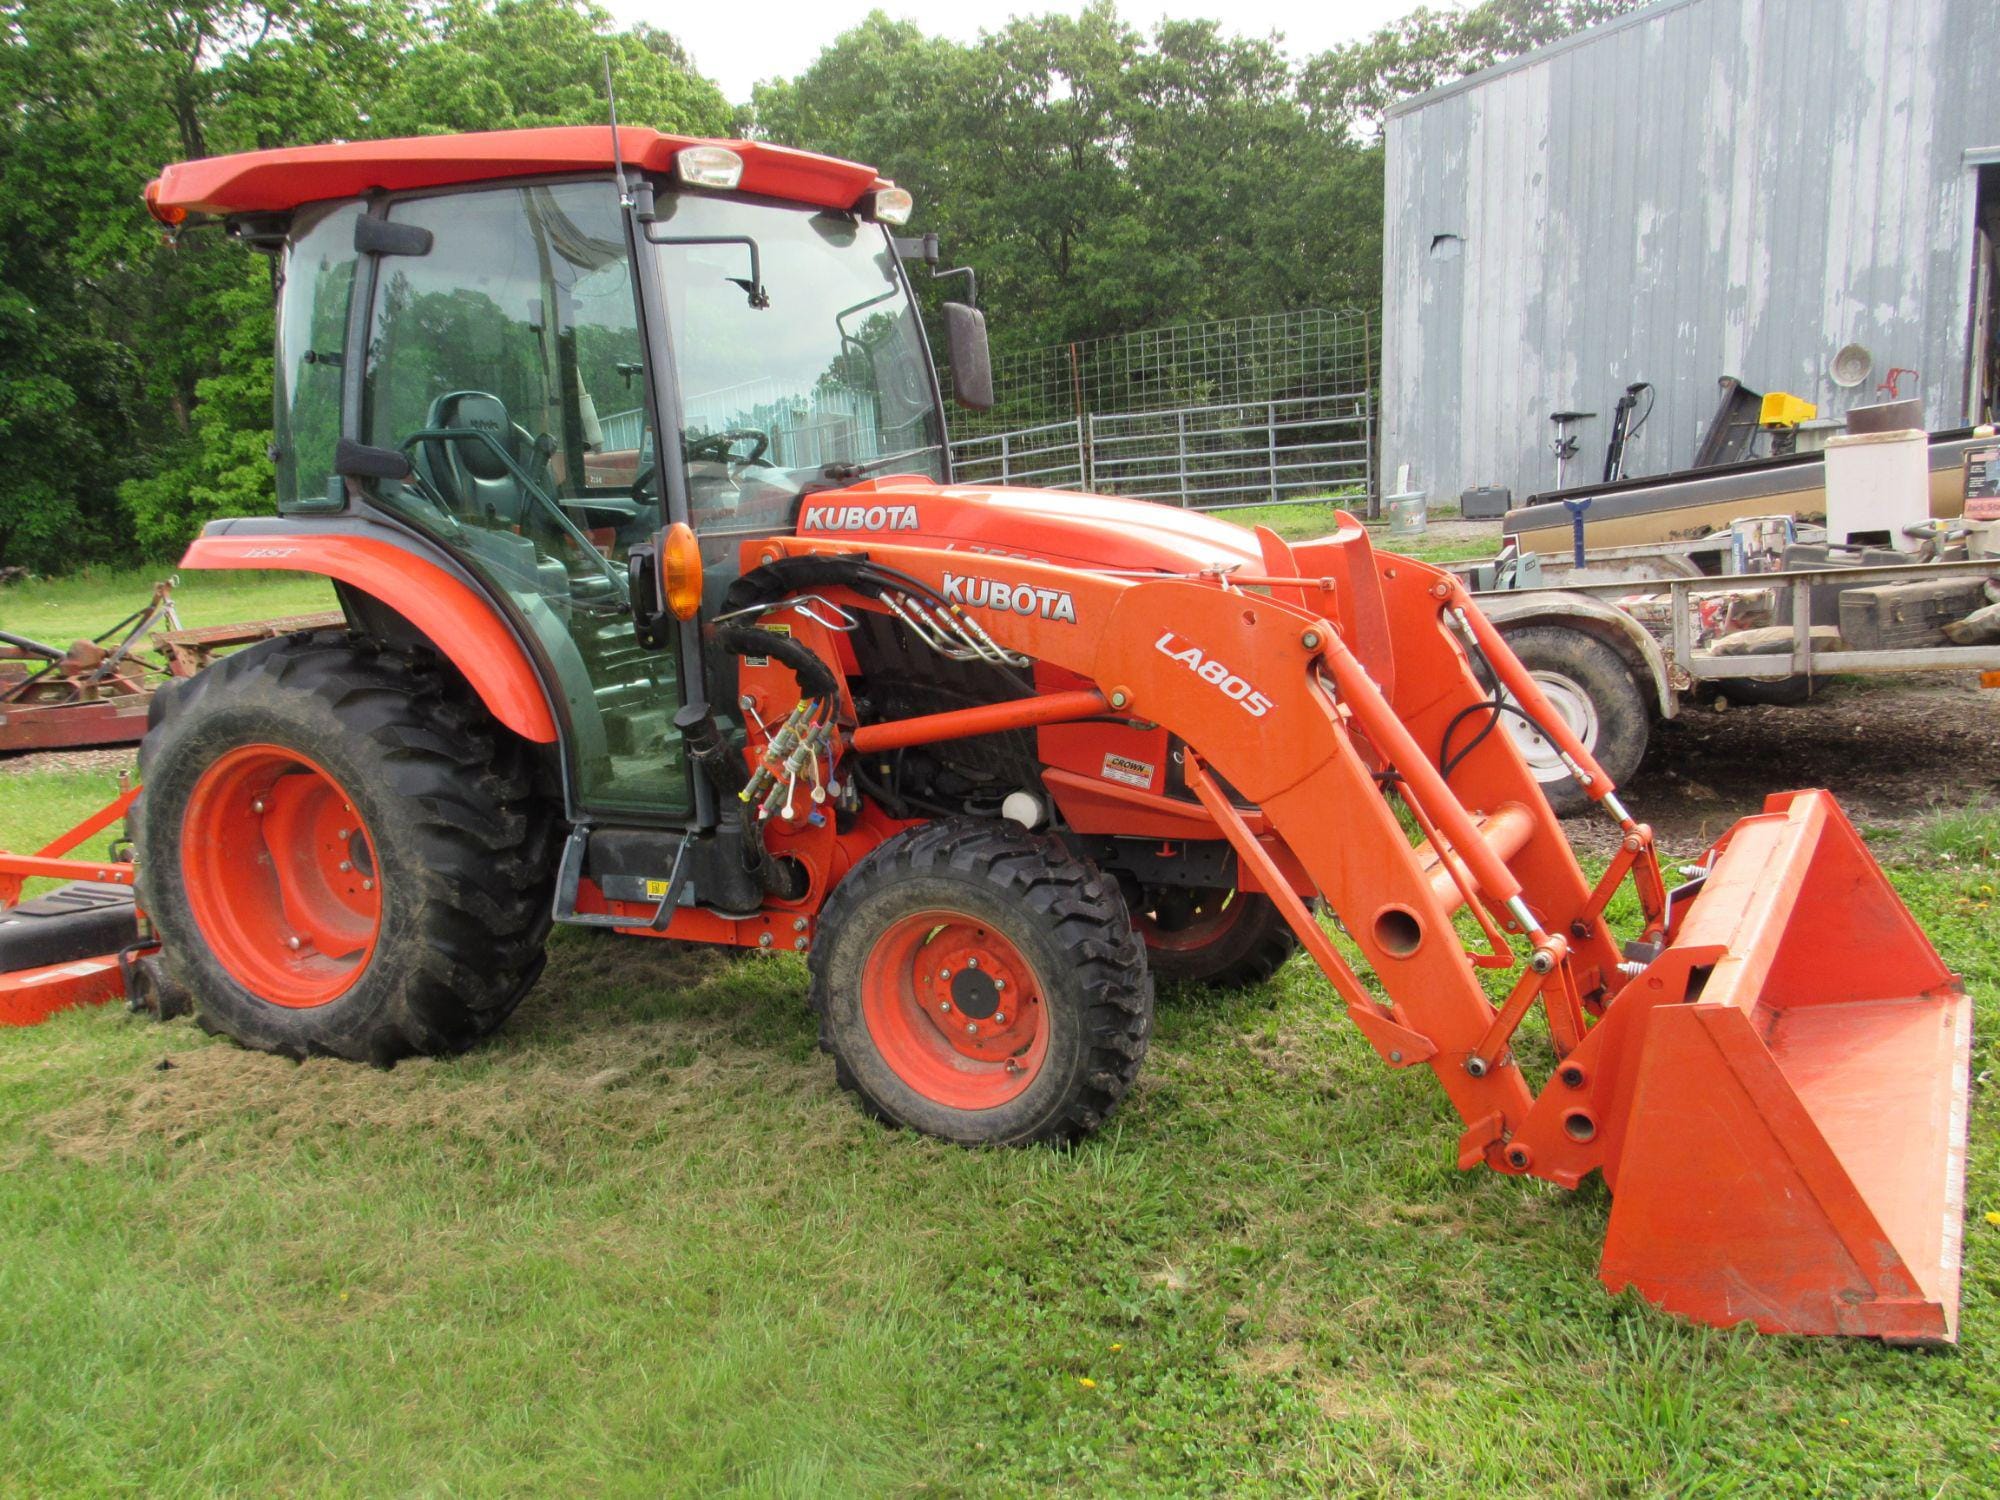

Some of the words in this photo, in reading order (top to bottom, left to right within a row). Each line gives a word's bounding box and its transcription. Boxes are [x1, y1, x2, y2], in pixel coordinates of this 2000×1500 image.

[803, 505, 919, 530] KUBOTA
[942, 572, 1077, 624] KUBOTA
[1155, 632, 1274, 717] LA805
[1111, 758, 1146, 773] CROWN
